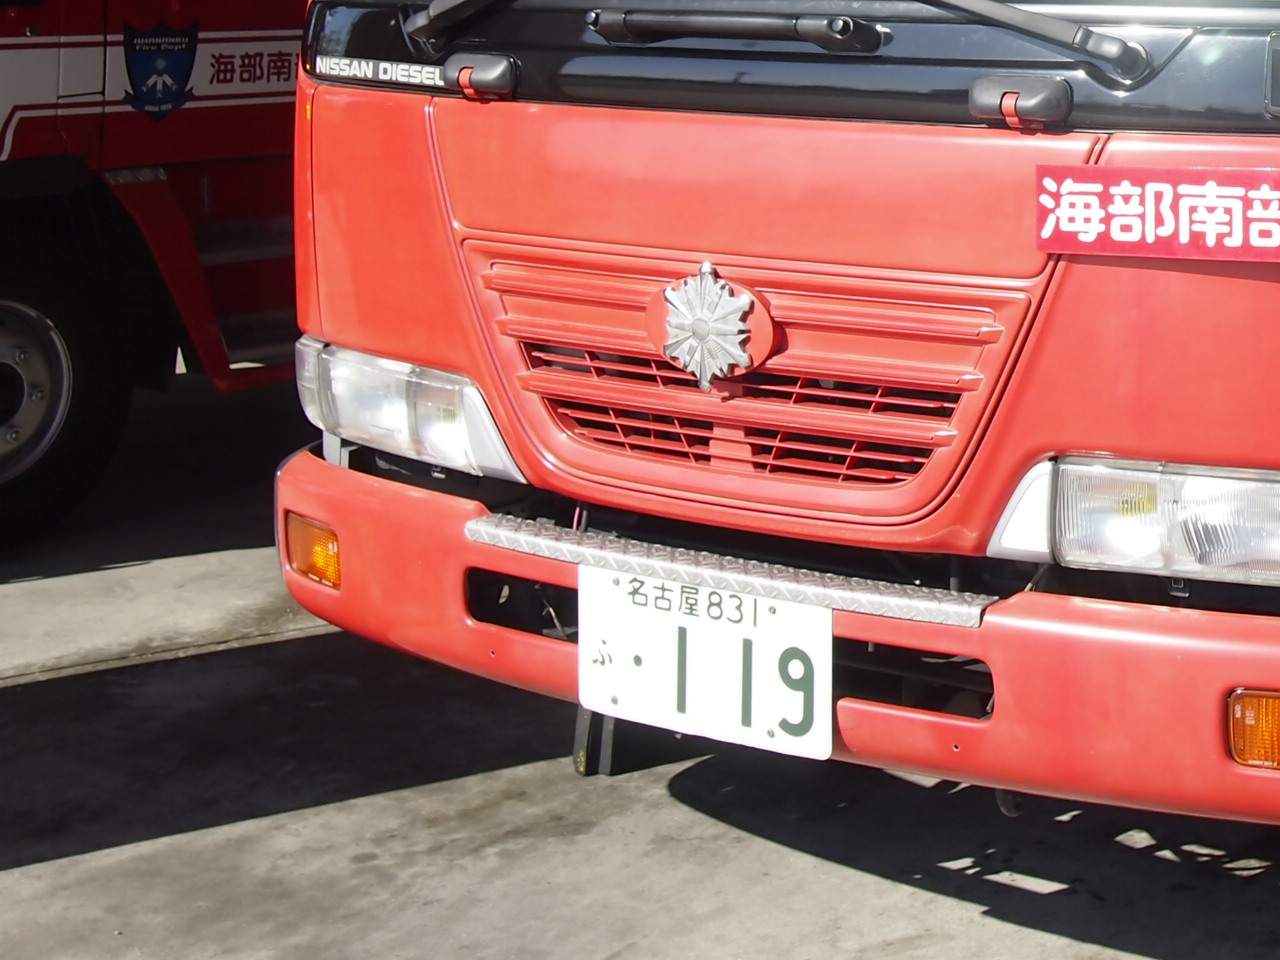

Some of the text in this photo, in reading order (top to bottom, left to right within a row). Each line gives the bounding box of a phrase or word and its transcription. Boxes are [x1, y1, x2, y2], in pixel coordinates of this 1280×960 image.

[209, 51, 299, 85] 海部南
[315, 56, 445, 86] NISSAN DIESEL
